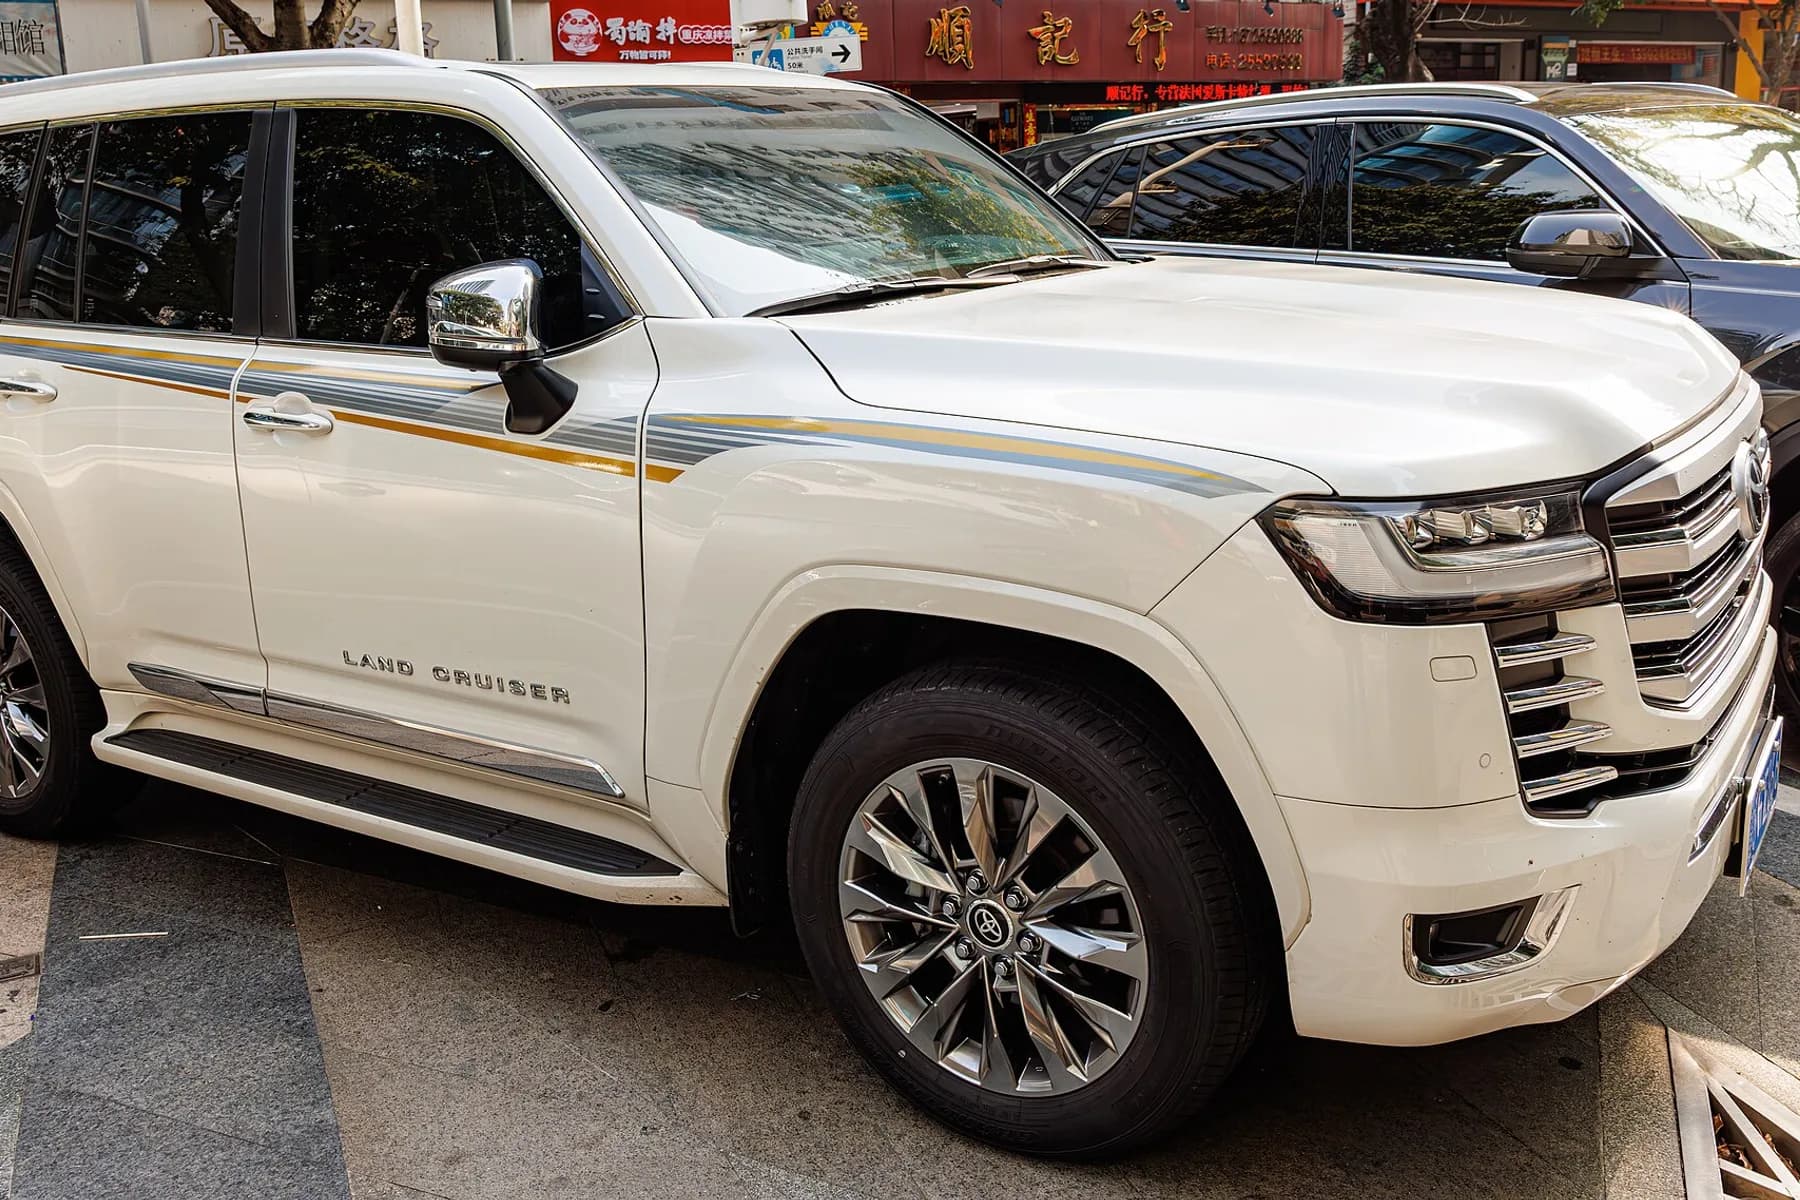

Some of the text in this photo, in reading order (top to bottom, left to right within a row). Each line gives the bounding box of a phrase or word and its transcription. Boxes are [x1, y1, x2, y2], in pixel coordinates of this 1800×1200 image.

[786, 45, 824, 56] 公共洗手间
[925, 5, 1174, 71] 順記行
[342, 650, 572, 705] LAND CRUISER
